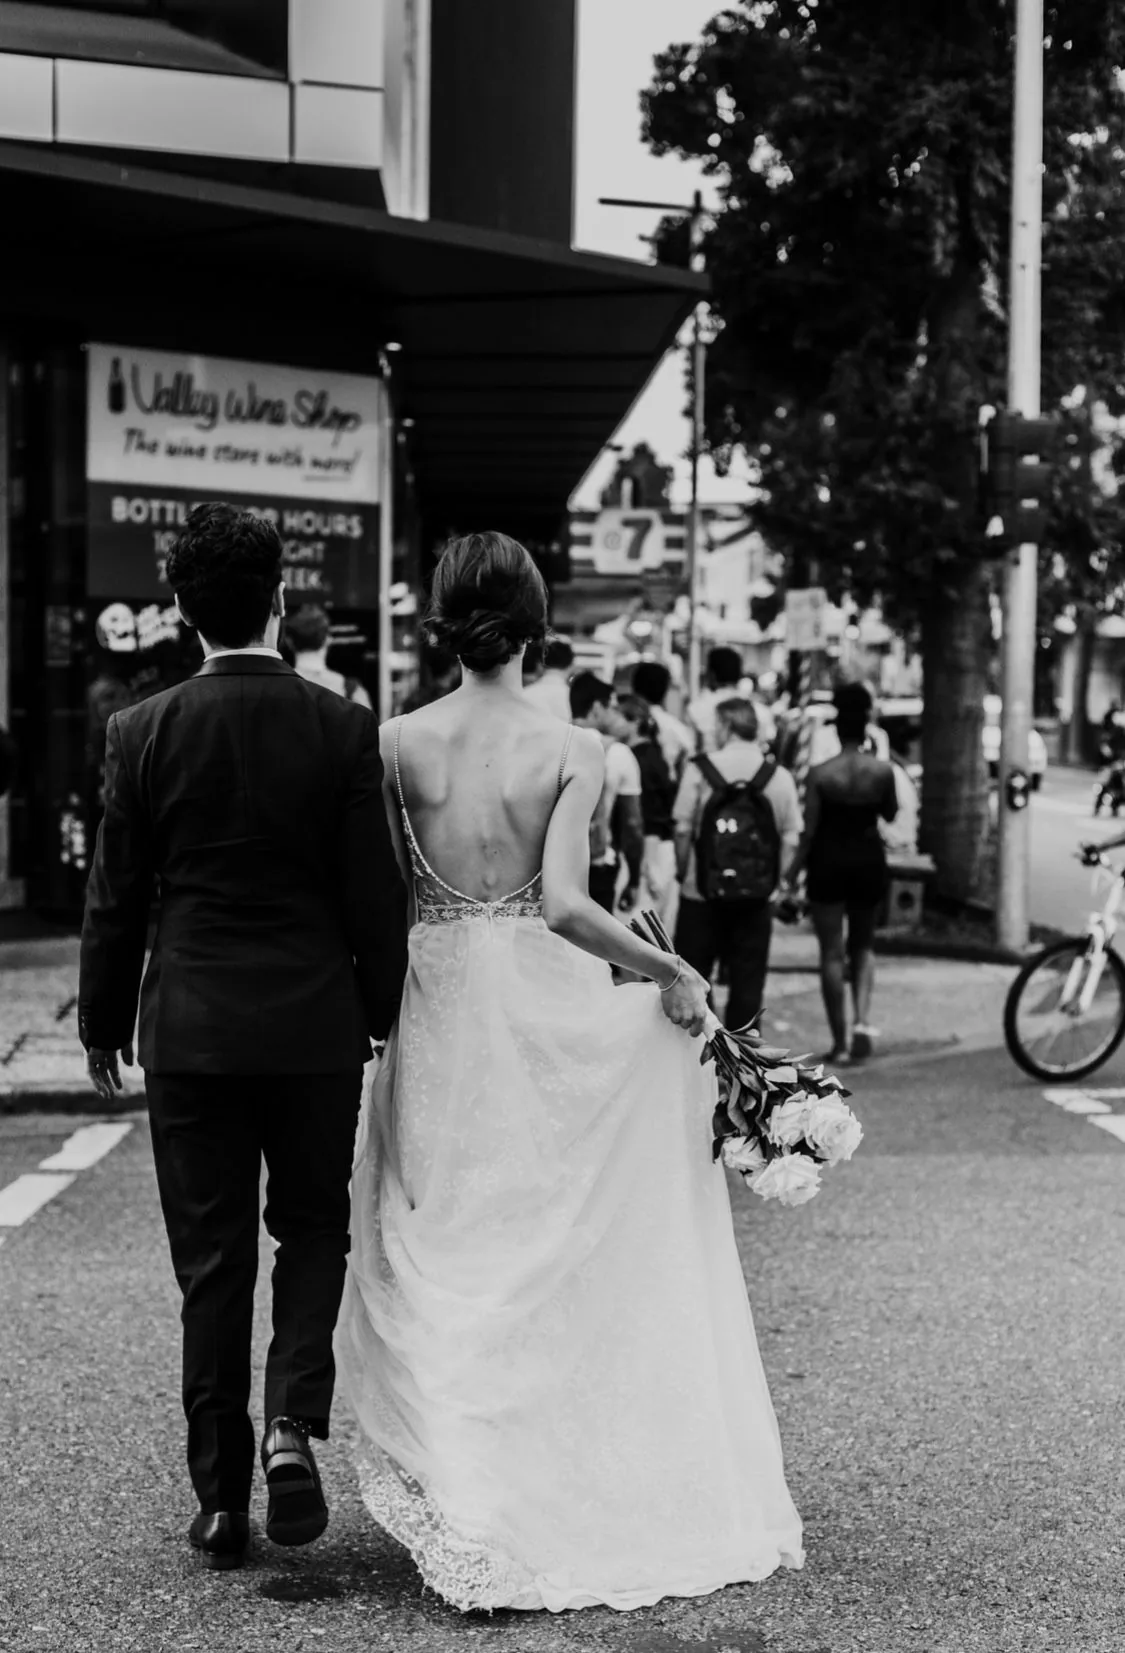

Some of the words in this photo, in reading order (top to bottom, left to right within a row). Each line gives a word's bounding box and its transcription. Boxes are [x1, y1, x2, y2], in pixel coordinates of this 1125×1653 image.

[130, 362, 218, 433] Valley
[224, 381, 287, 427] Wine
[291, 389, 362, 448] Shop
[122, 427, 159, 456] The
[266, 445, 303, 468] with
[111, 496, 201, 525] BOTTL
[282, 508, 363, 539] HOURS
[621, 518, 653, 561] 7
